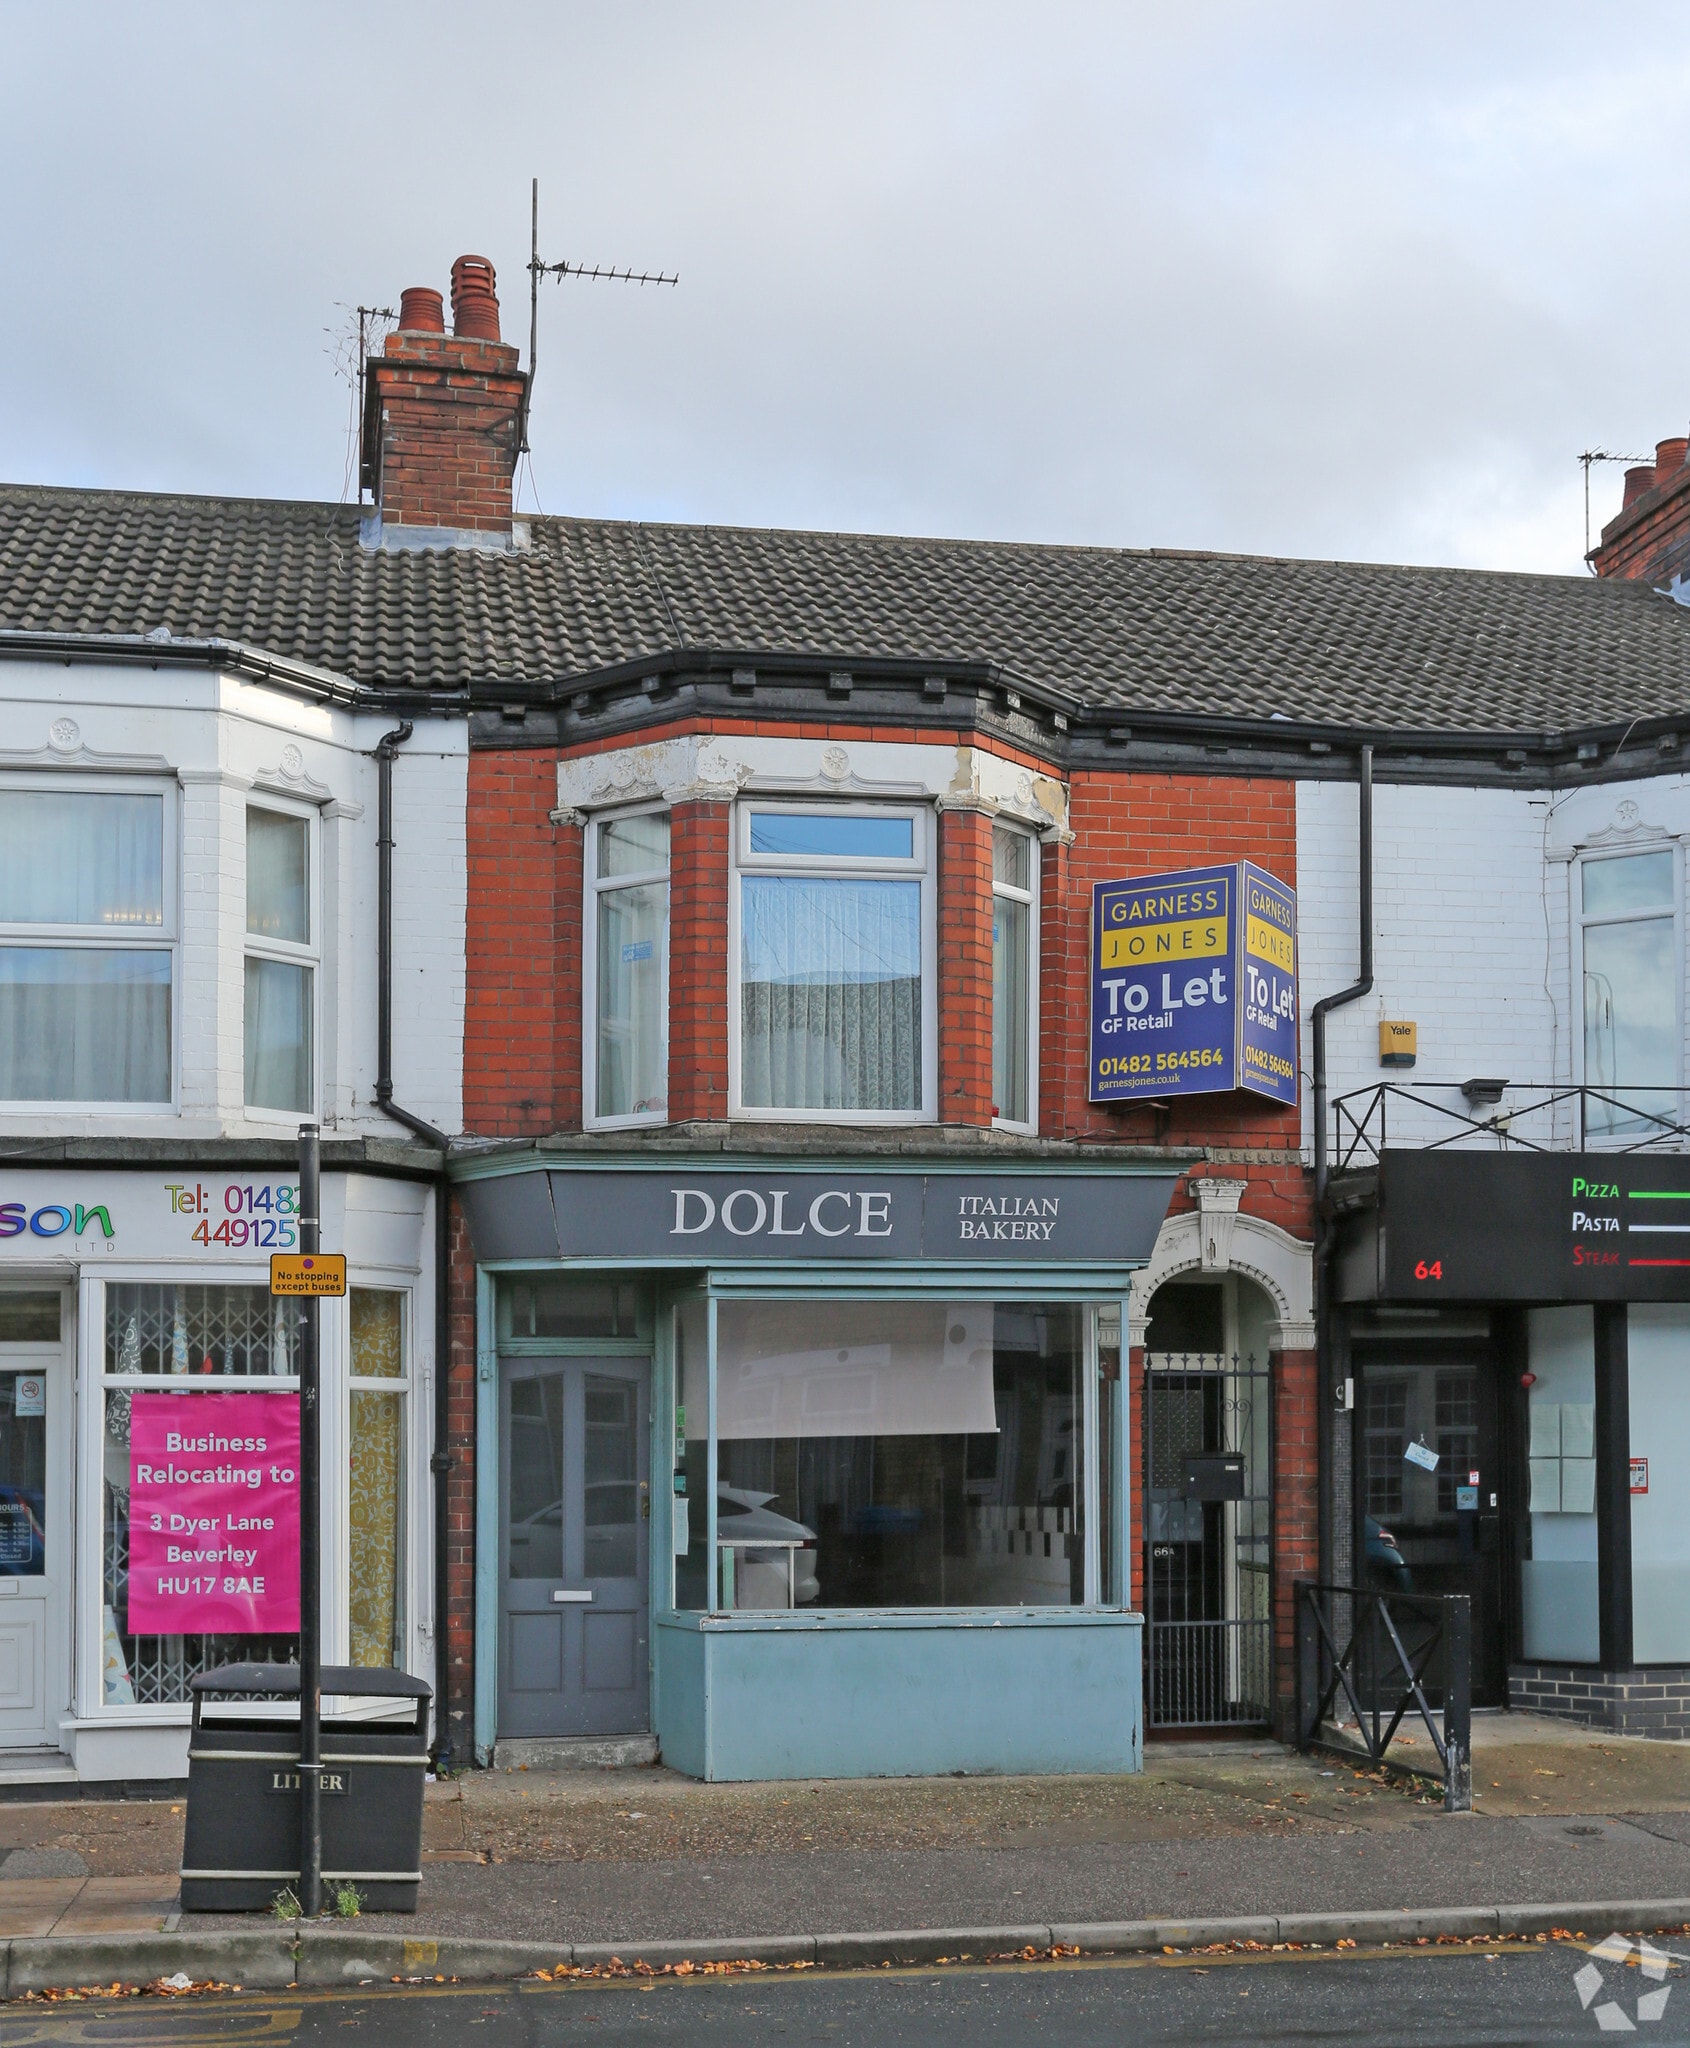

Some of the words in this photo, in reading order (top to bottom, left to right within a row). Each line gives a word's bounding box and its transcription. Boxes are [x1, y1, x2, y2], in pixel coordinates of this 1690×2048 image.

[1111, 890, 1217, 922] GARNESS
[1251, 889, 1291, 929] GARNESS
[1111, 927, 1217, 958] JONES
[1251, 926, 1291, 964] JONES
[1102, 978, 1149, 1015] To
[1162, 967, 1228, 1010] Let
[1247, 964, 1268, 1007] To
[1272, 976, 1294, 1022] Let
[1101, 1017, 1122, 1034] GF
[1127, 1012, 1173, 1031] Retail
[1246, 1005, 1257, 1022] GF
[1258, 1009, 1277, 1031] Retail
[1390, 1026, 1411, 1035] Yale
[1099, 1054, 1151, 1076] 01482
[1156, 1048, 1223, 1070] 564564
[1245, 1045, 1268, 1070] 01482
[1269, 1054, 1293, 1080] 564564
[1098, 1073, 1181, 1091] garnessjones.co.uk
[164, 1184, 208, 1214] Tel:
[959, 1196, 1059, 1217] ITALIAN
[0, 1203, 115, 1237] son
[669, 1189, 894, 1237] DOLCE
[191, 1218, 296, 1247] 449125
[959, 1220, 1057, 1240] BAKERY
[277, 1272, 292, 1280] No
[295, 1272, 339, 1282] stopping
[1414, 1260, 1443, 1280] 64
[275, 1283, 309, 1292] except
[311, 1283, 341, 1291] buses
[166, 1432, 267, 1453] Business
[137, 1463, 262, 1489] Relocating
[269, 1465, 295, 1484] to
[150, 1514, 162, 1531] 3
[169, 1514, 219, 1535] Dyer
[226, 1514, 274, 1531] Lane
[167, 1544, 257, 1567] Beverley
[1154, 1547, 1175, 1557] 66A
[157, 1577, 216, 1595] HU17
[223, 1576, 265, 1594] 8AE
[273, 1774, 343, 1790] LITER
